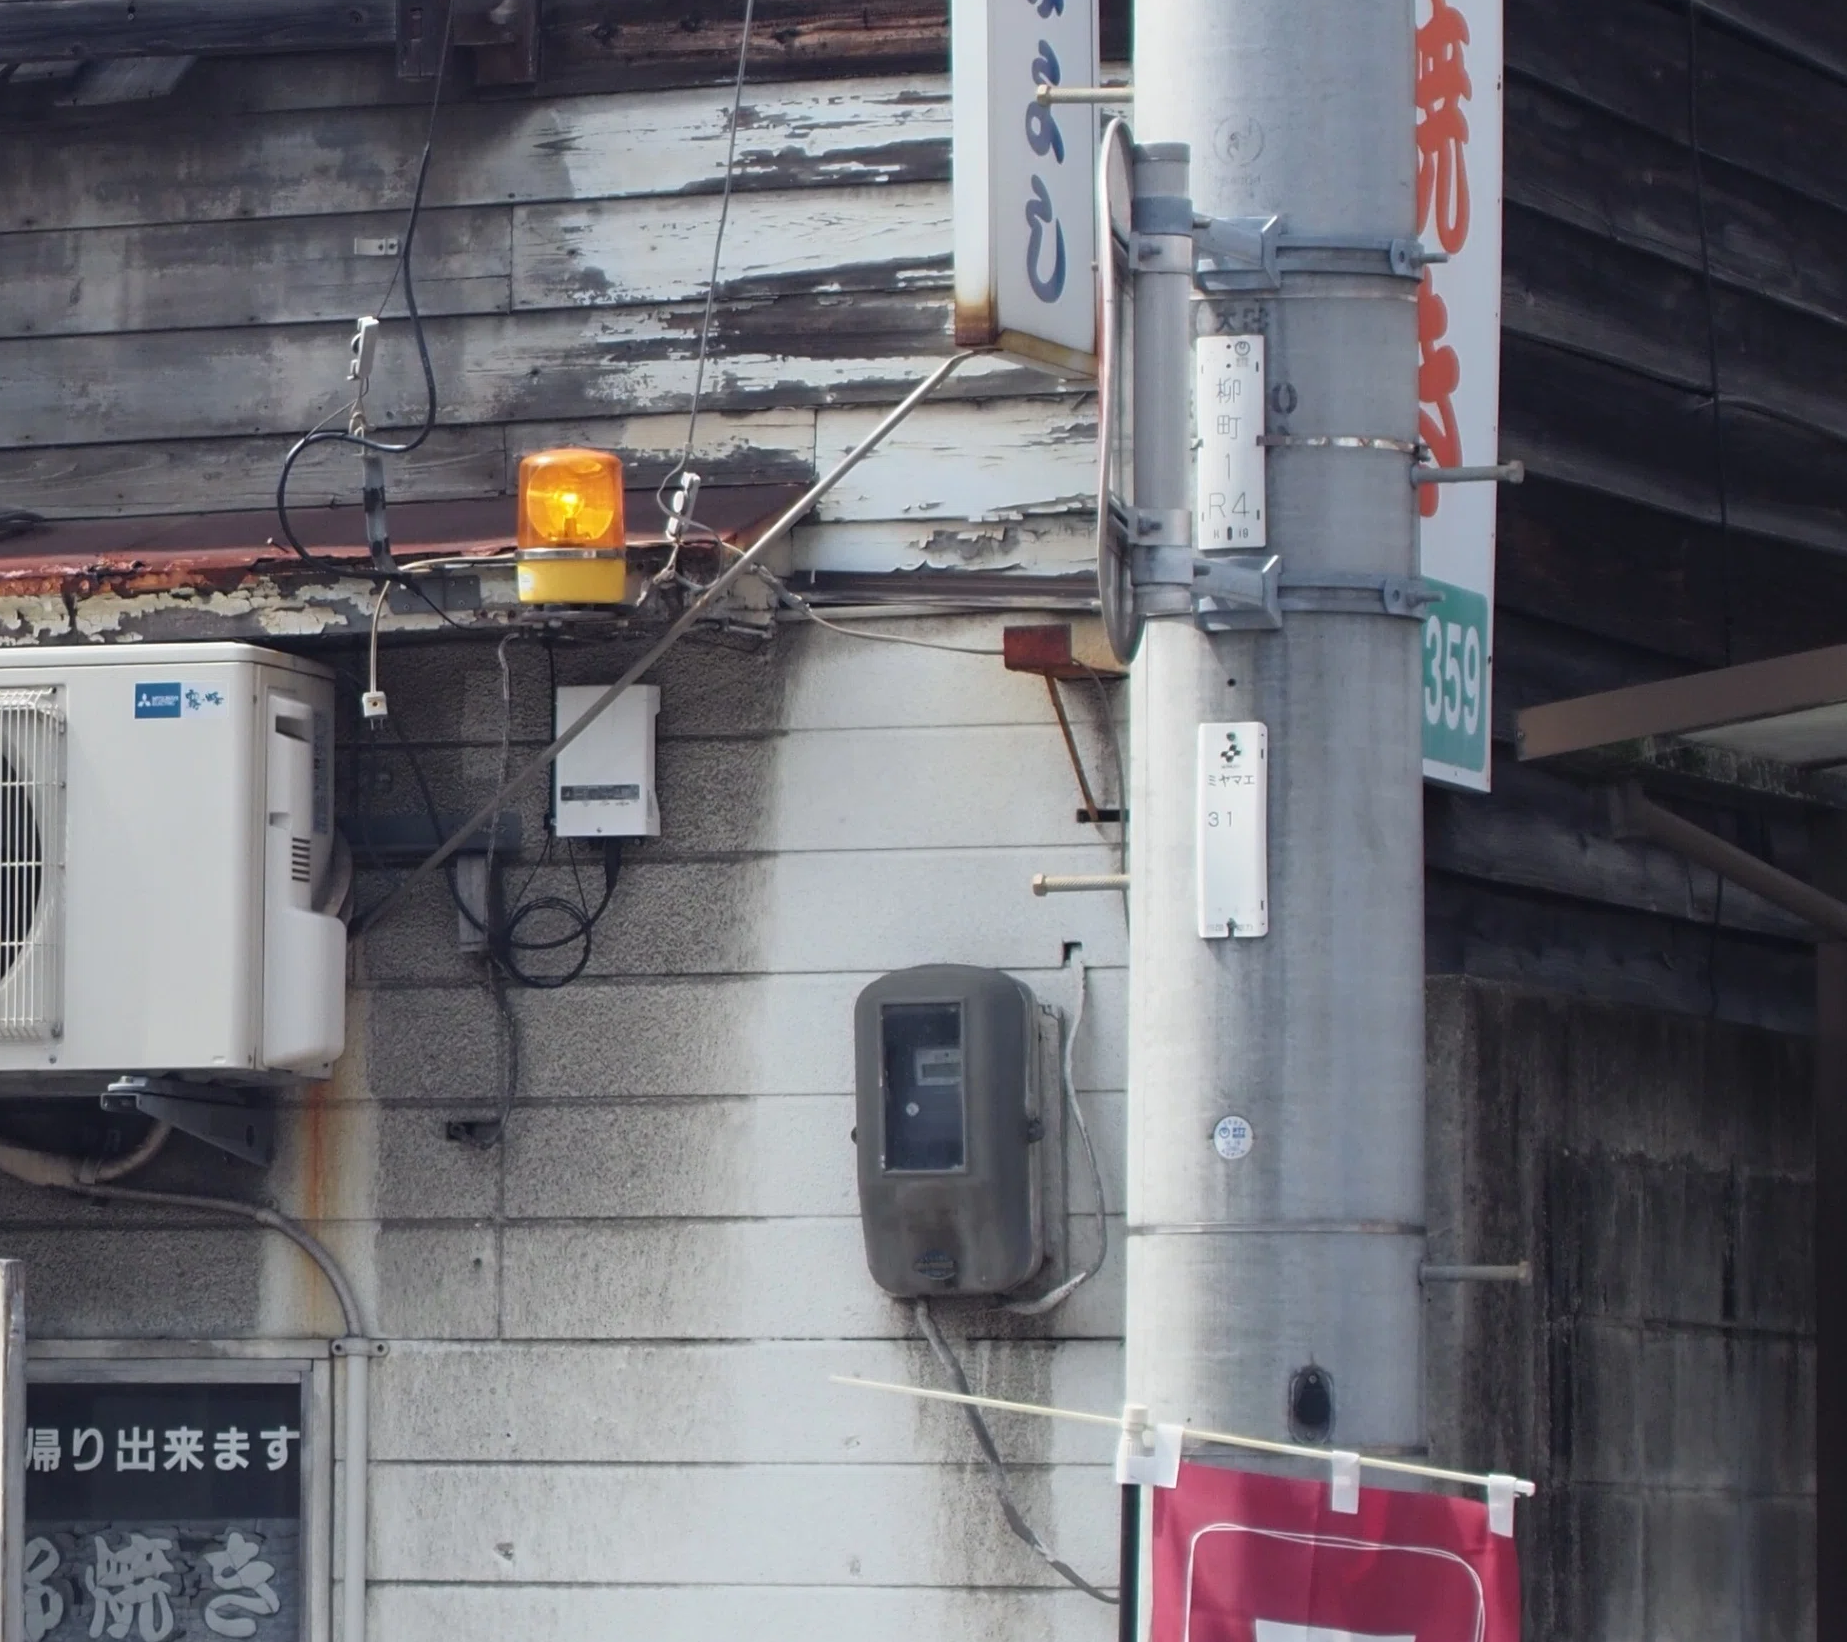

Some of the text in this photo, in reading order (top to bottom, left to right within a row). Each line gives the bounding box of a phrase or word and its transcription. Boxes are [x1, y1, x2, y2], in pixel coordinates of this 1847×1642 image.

[1207, 773, 1255, 788] ミヤマエ
[1208, 811, 1234, 828] 31
